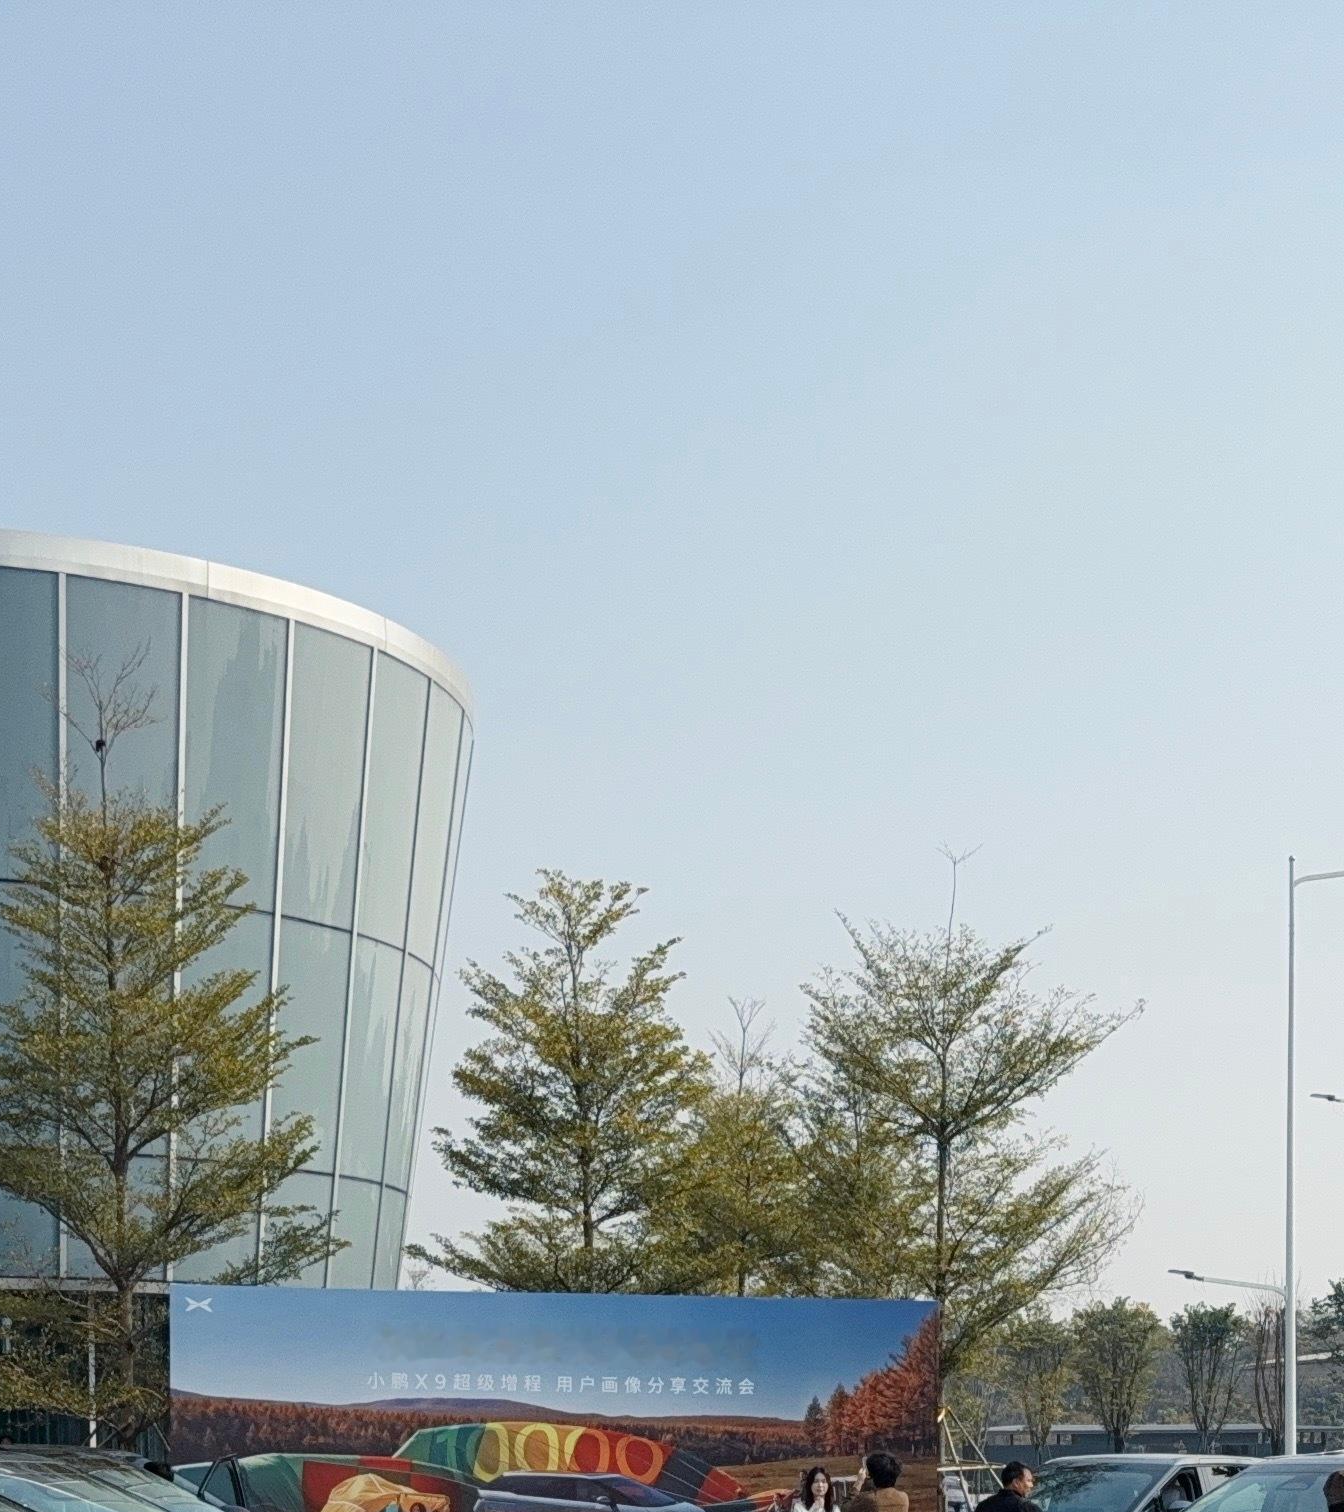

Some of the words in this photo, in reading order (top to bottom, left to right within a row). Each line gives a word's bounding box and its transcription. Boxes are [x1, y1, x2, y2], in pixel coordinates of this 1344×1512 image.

[367, 1371, 542, 1393] 小鹏X9超级增程
[557, 1375, 756, 1395] 用户画像分享交流会
[435, 1421, 664, 1485] 10000
